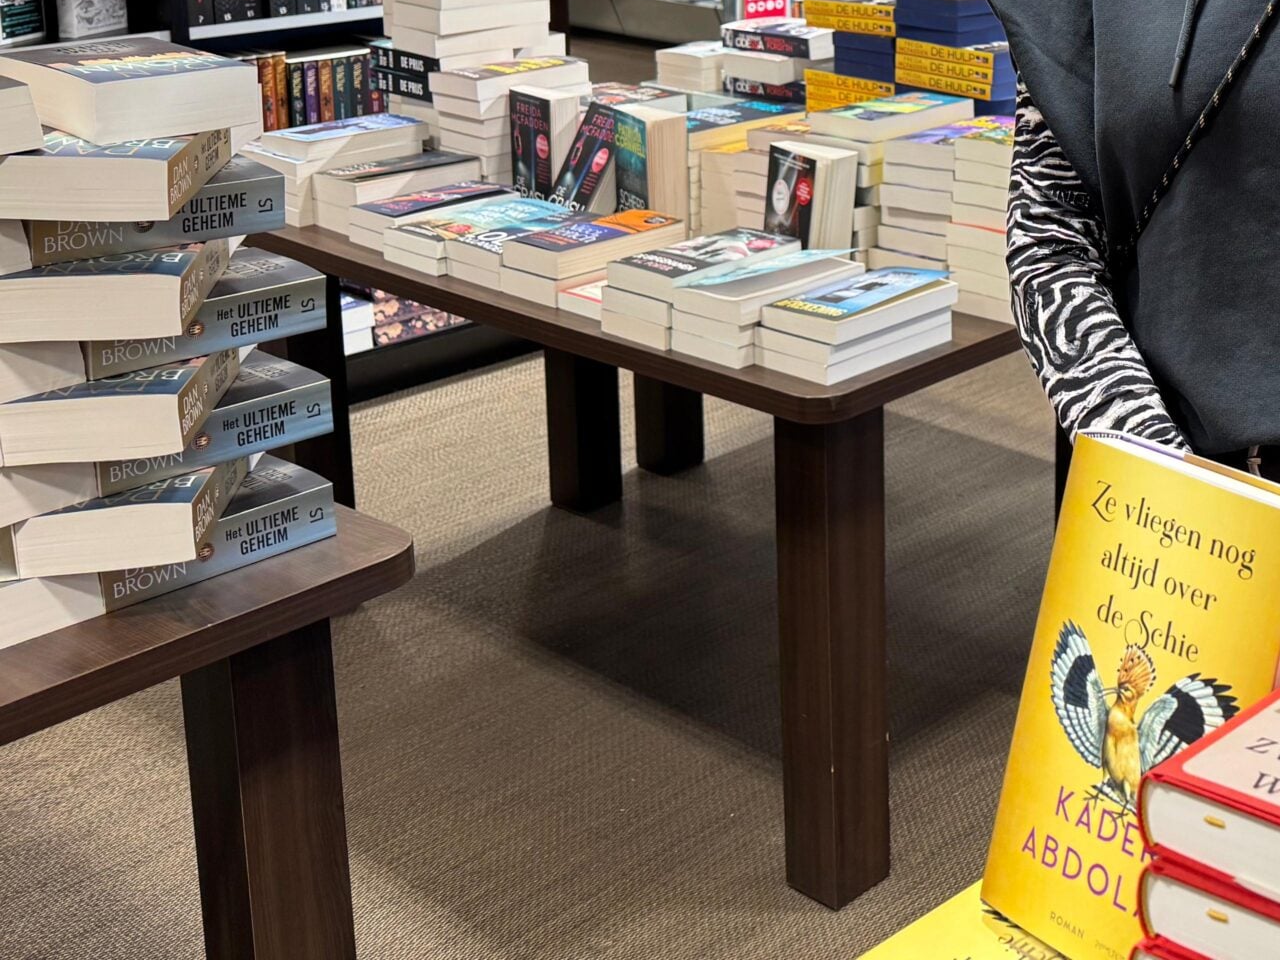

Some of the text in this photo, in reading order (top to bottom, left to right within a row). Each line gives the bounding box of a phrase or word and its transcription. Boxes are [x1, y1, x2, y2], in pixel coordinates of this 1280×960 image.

[836, 3, 849, 14] DE
[852, 6, 878, 17] HULP
[837, 19, 850, 30] DE
[853, 20, 879, 31] HULP
[400, 55, 408, 65] DE
[408, 57, 424, 72] PRIJS
[931, 47, 975, 61] DE HULP
[930, 62, 974, 77] DE HULP
[399, 79, 407, 89] DE
[407, 81, 423, 96] PRIJS
[836, 77, 849, 87] DE
[851, 79, 879, 91] HULP
[928, 77, 973, 93] DE HULP
[511, 113, 549, 130] MCFADDEN
[516, 102, 541, 117] FREIDA
[592, 114, 615, 129] FREID
[582, 125, 615, 142] MCFADDE
[173, 156, 188, 184] DAN
[169, 171, 192, 205] BROWN
[513, 184, 545, 201] CRAS
[190, 191, 248, 214] ULTIEME
[182, 211, 234, 234] GEHEIM
[43, 227, 124, 254] BROWN
[183, 269, 196, 299] DAN
[216, 293, 292, 322] Het ULTIEME
[230, 313, 279, 338] GEHEIM
[101, 336, 176, 366] BROWN
[183, 384, 198, 415] DAN
[182, 396, 204, 436] BROWN
[222, 400, 297, 432] Het ULTIEME
[236, 420, 286, 447] GEHEIM
[109, 451, 184, 484] BROWN
[196, 489, 210, 522] DAN
[195, 502, 214, 543] BROWN
[225, 506, 300, 542] Het ULTIEME
[1089, 478, 1257, 580] Ze vliegen nog
[239, 526, 289, 555] GEHEIM
[112, 561, 188, 599] BROWN
[1100, 545, 1218, 612] altijd over
[1096, 594, 1200, 663] de Schie
[1021, 826, 1140, 918] ABDOL
[1050, 911, 1085, 940] ROMAN
